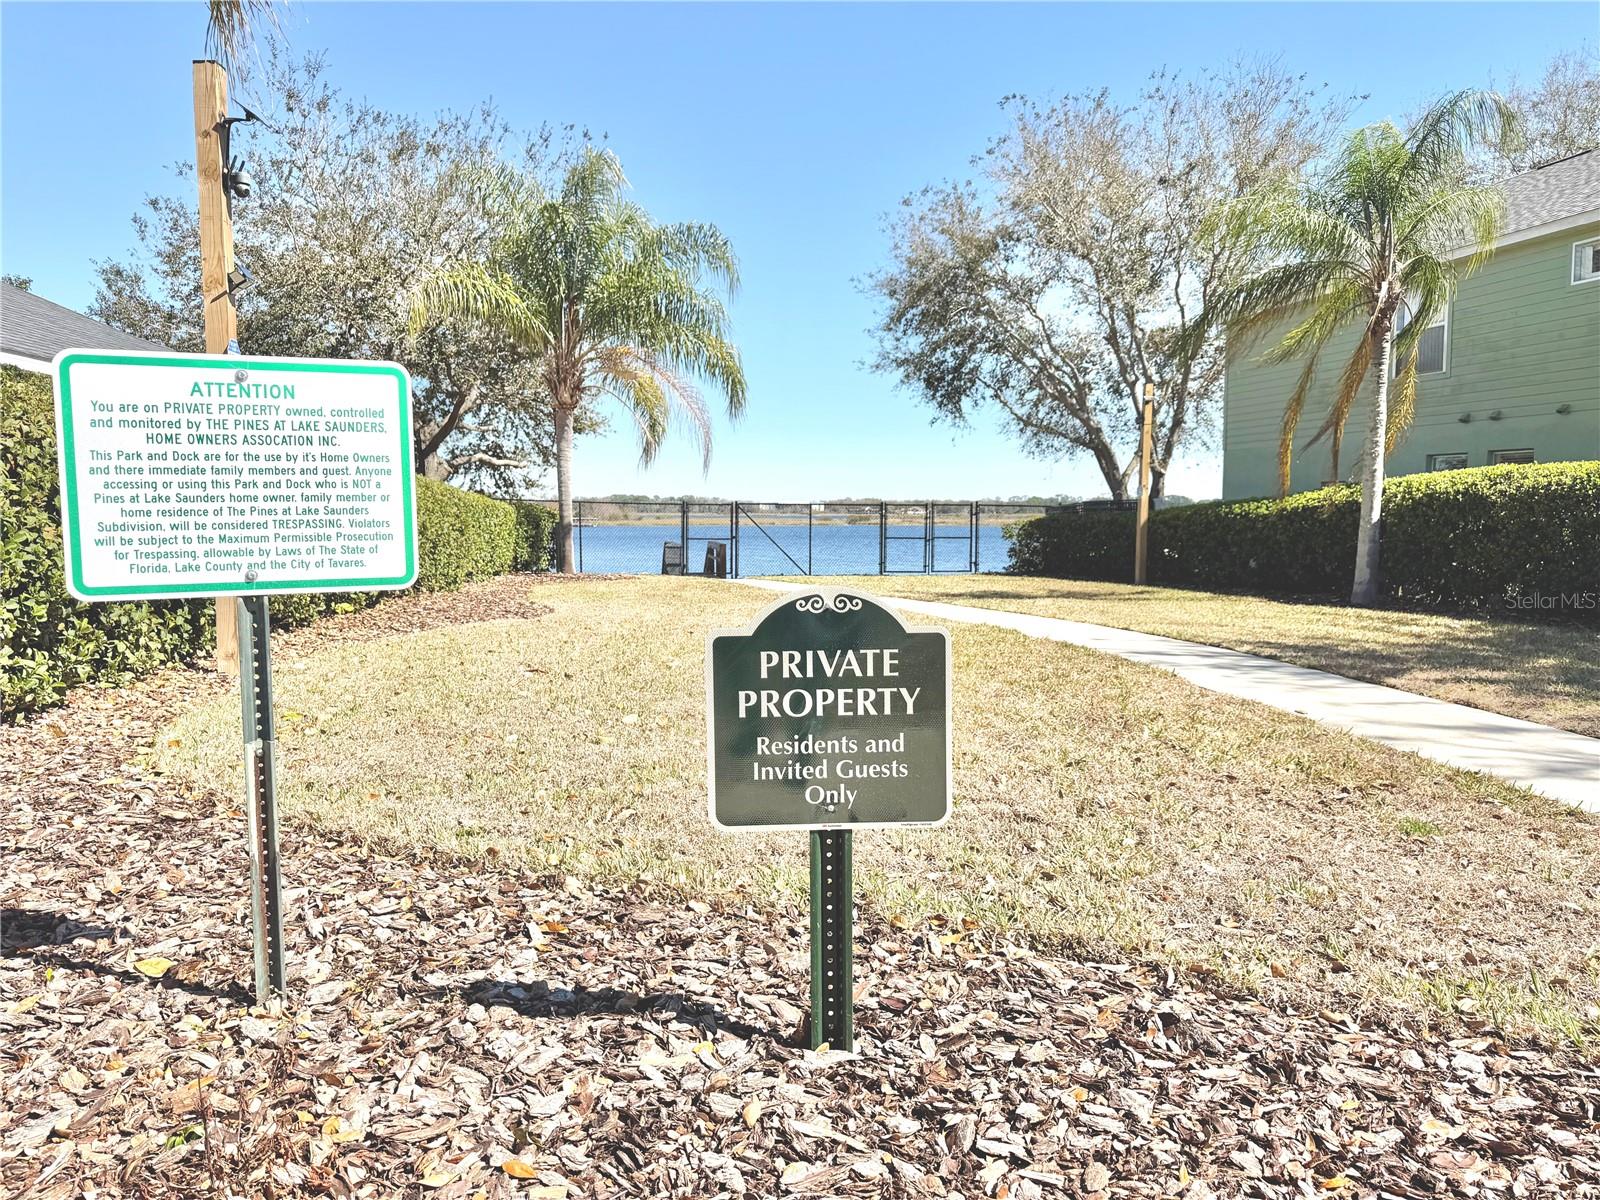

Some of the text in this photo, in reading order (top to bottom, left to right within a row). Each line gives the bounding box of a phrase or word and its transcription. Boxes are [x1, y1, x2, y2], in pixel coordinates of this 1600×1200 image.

[190, 382, 294, 398] ATTENTION
[91, 400, 114, 412] You
[119, 404, 139, 412] are
[144, 404, 159, 413] on
[164, 402, 213, 414] PRIVATE
[218, 403, 281, 416] PROPERTY
[330, 407, 385, 419] controlled
[90, 416, 113, 428] and
[118, 417, 182, 429] monitored
[186, 419, 202, 432] by
[206, 418, 229, 430] THE
[234, 419, 270, 431] PINES
[274, 420, 286, 431] AT
[291, 420, 320, 432] LAKE
[146, 432, 340, 447] HOME OWNERS ASSOCATION INC.
[90, 450, 113, 461] This
[117, 450, 143, 461] Park
[147, 451, 168, 461] and
[172, 451, 200, 462] Dock
[204, 453, 222, 462] are
[225, 451, 240, 462] for
[243, 452, 261, 462] the
[286, 452, 299, 464] by
[302, 452, 317, 462] it's
[320, 452, 349, 462] Home
[353, 453, 390, 463] Owners
[89, 465, 392, 479] and there immediate family members and guest. Anyone
[103, 479, 158, 492] accessing
[162, 481, 174, 489] or
[178, 479, 207, 492] using
[211, 479, 231, 489] this
[235, 479, 259, 489] Park
[262, 479, 282, 489] and
[286, 479, 312, 489] Dock
[315, 478, 337, 489] who
[341, 479, 349, 489] is
[352, 479, 372, 489] NOT
[94, 493, 126, 504] Pines
[129, 493, 140, 504] at
[144, 491, 171, 504] Lake
[175, 491, 226, 503] Saunders
[229, 493, 259, 503] home
[301, 492, 333, 504] family
[336, 493, 377, 502] member
[121, 505, 370, 518] home residence of The Pines at Lake Saunders
[169, 521, 190, 531] will
[194, 521, 208, 531] be
[211, 520, 268, 530] considered
[348, 518, 390, 528] Violators
[94, 531, 394, 548] will be subject to the Maximum Permissible Prosecution
[114, 550, 130, 560] for
[203, 547, 255, 558] allowable
[258, 547, 272, 558] by
[276, 546, 302, 556] Laws
[306, 546, 316, 555] of
[319, 545, 337, 555] The
[340, 544, 366, 555] State
[369, 544, 378, 554] of
[175, 562, 201, 573] Lake
[205, 561, 243, 574] County
[247, 560, 266, 571] and
[270, 560, 287, 570] the
[291, 559, 311, 571] City
[314, 559, 324, 568] of
[328, 558, 366, 568] Tavares.
[759, 648, 899, 679] PRIVATE
[738, 687, 921, 718] PROPERTY
[756, 733, 905, 756] Residents and
[753, 759, 908, 780] Invited Guests
[804, 784, 858, 809] Only
